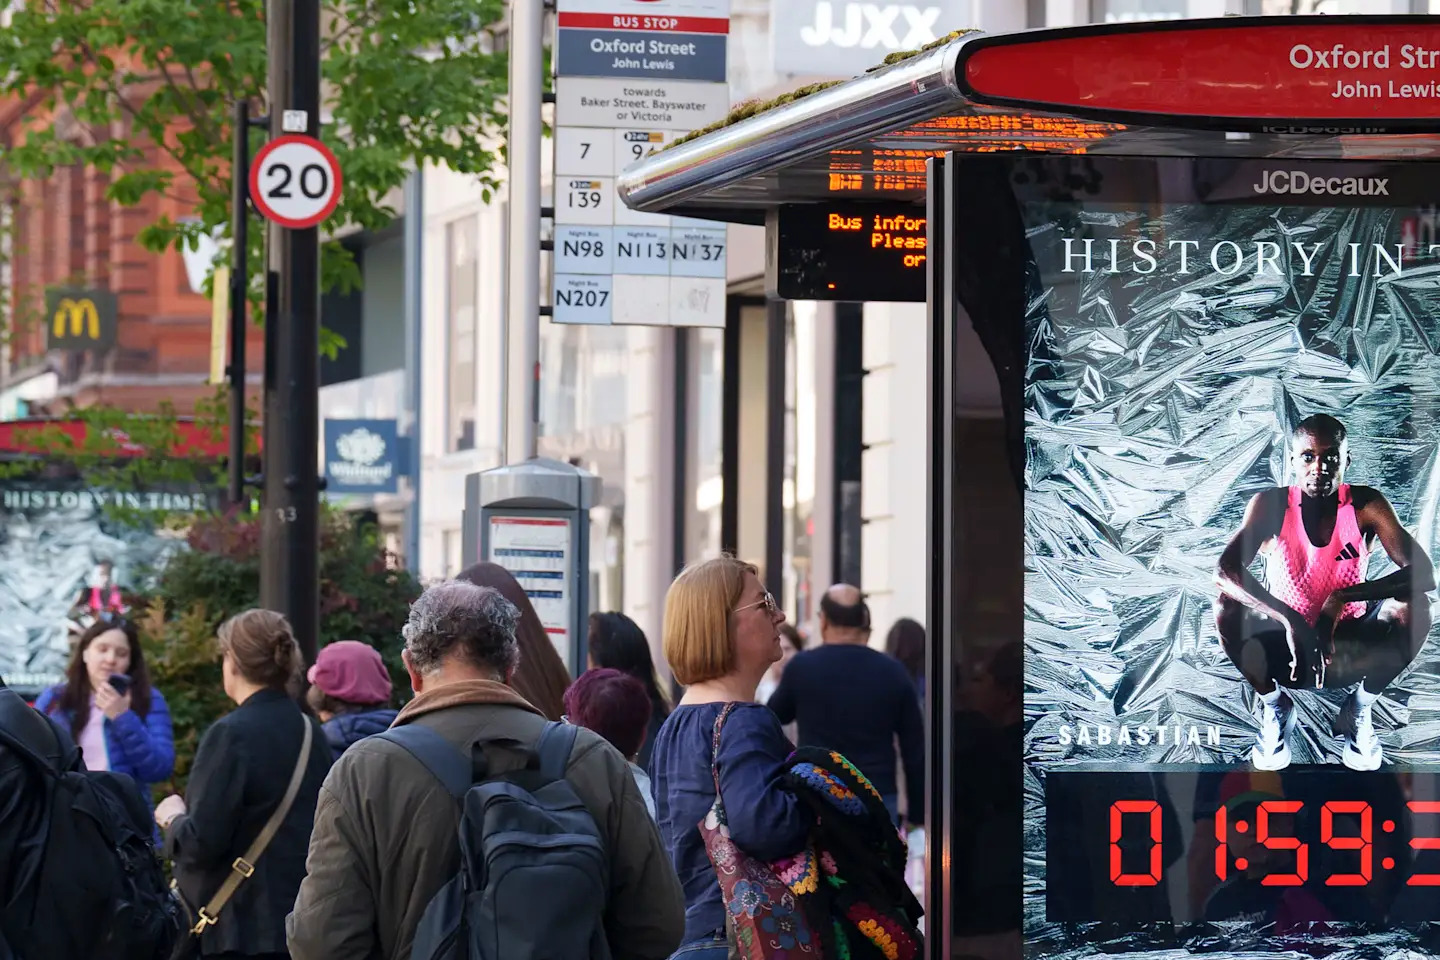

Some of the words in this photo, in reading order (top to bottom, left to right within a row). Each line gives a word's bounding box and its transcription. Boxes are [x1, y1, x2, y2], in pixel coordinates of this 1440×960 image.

[613, 16, 639, 28] BUS
[644, 18, 678, 29] STOP
[800, 2, 941, 49] JJXX
[590, 38, 645, 54] Oxford
[649, 40, 696, 56] Street
[612, 57, 640, 69] John
[642, 58, 675, 70] Lewis
[1289, 44, 1390, 69] Oxford
[623, 87, 667, 97] towards
[1331, 80, 1382, 98] John
[580, 97, 610, 107] Baker
[652, 100, 707, 112] Bayswater
[616, 112, 628, 120] or
[632, 111, 672, 122] Victoria
[580, 142, 592, 159] 7
[267, 163, 328, 199] 20
[1254, 170, 1389, 195] JCDecaux
[568, 192, 601, 208] 139
[828, 213, 862, 230] Bus
[563, 241, 604, 257] N98
[618, 243, 666, 258] N113
[903, 254, 926, 268] or
[1061, 238, 1325, 277] HISTORY
[1348, 243, 1406, 278] IN
[556, 290, 609, 307] N207
[4, 490, 110, 509] HISTORY
[148, 492, 206, 511] TIME
[1059, 725, 1221, 745] SABASTIAN
